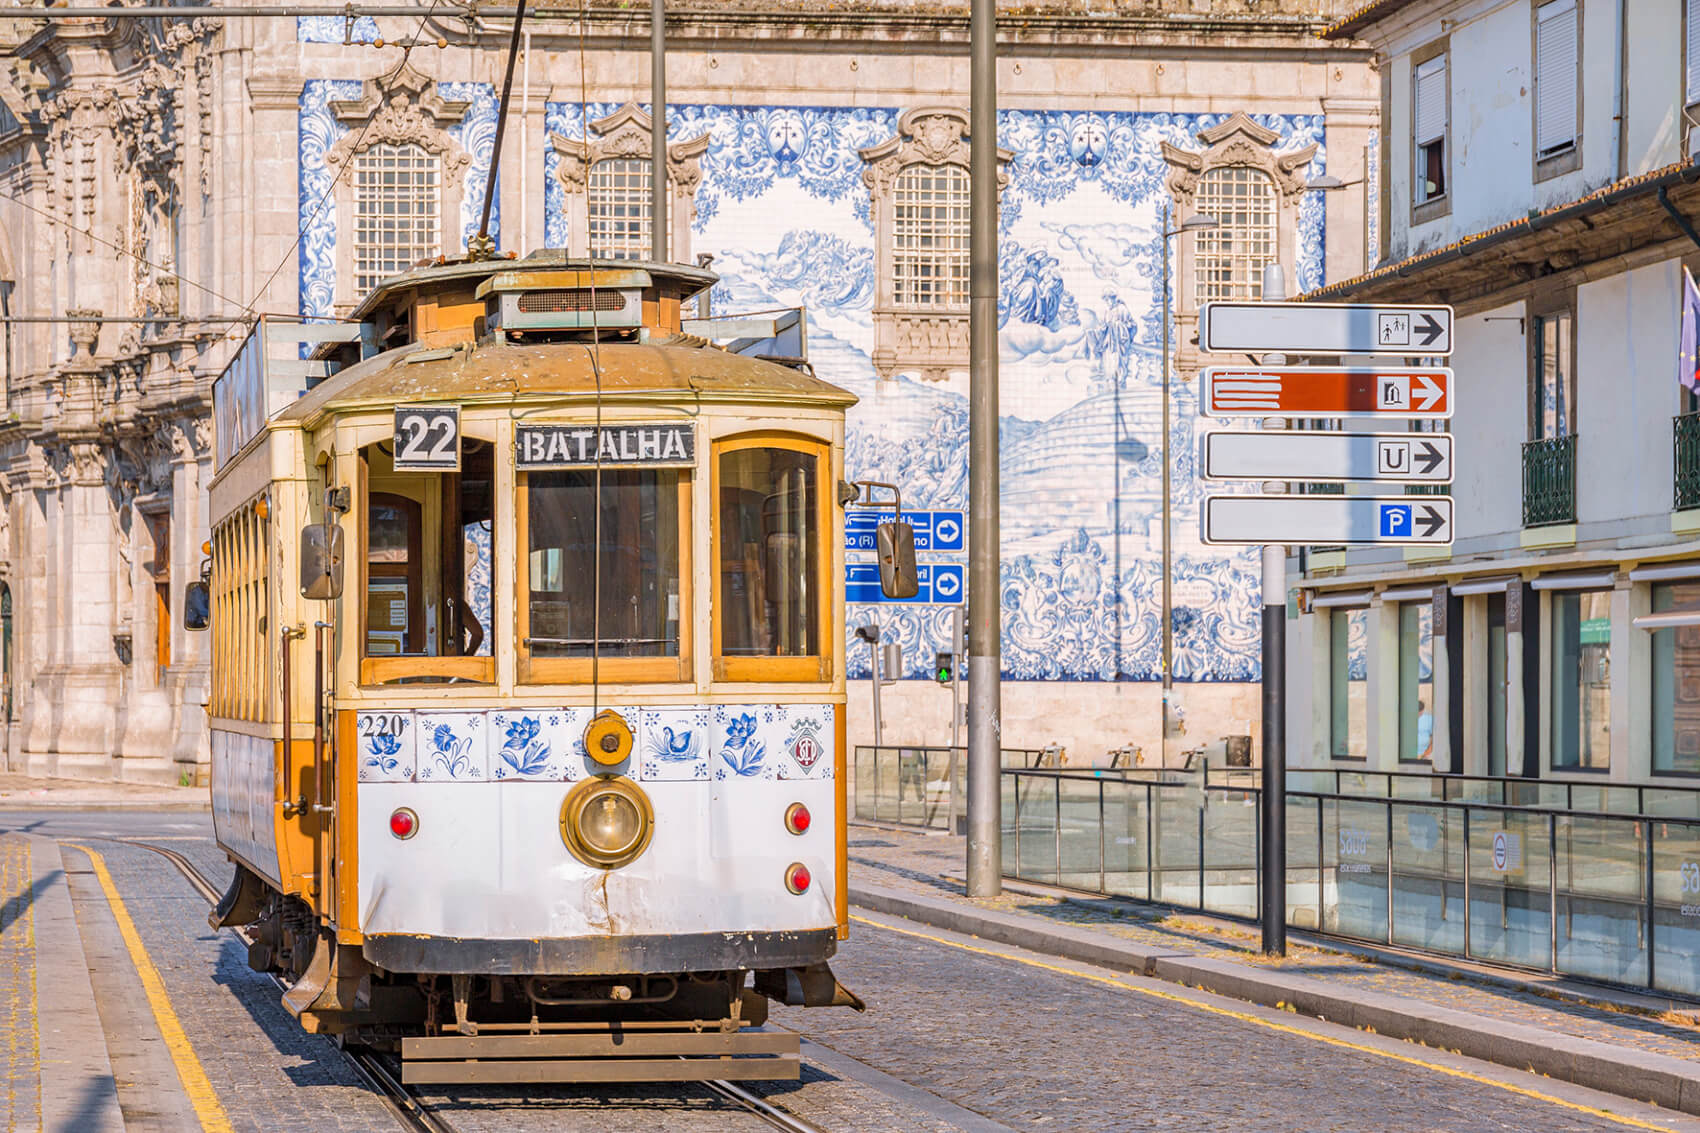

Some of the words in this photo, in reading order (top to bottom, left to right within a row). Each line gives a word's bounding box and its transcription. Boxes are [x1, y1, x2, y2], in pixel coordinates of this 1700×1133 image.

[400, 414, 456, 461] 22
[523, 428, 688, 462] BATALHA
[362, 714, 403, 737] 220
